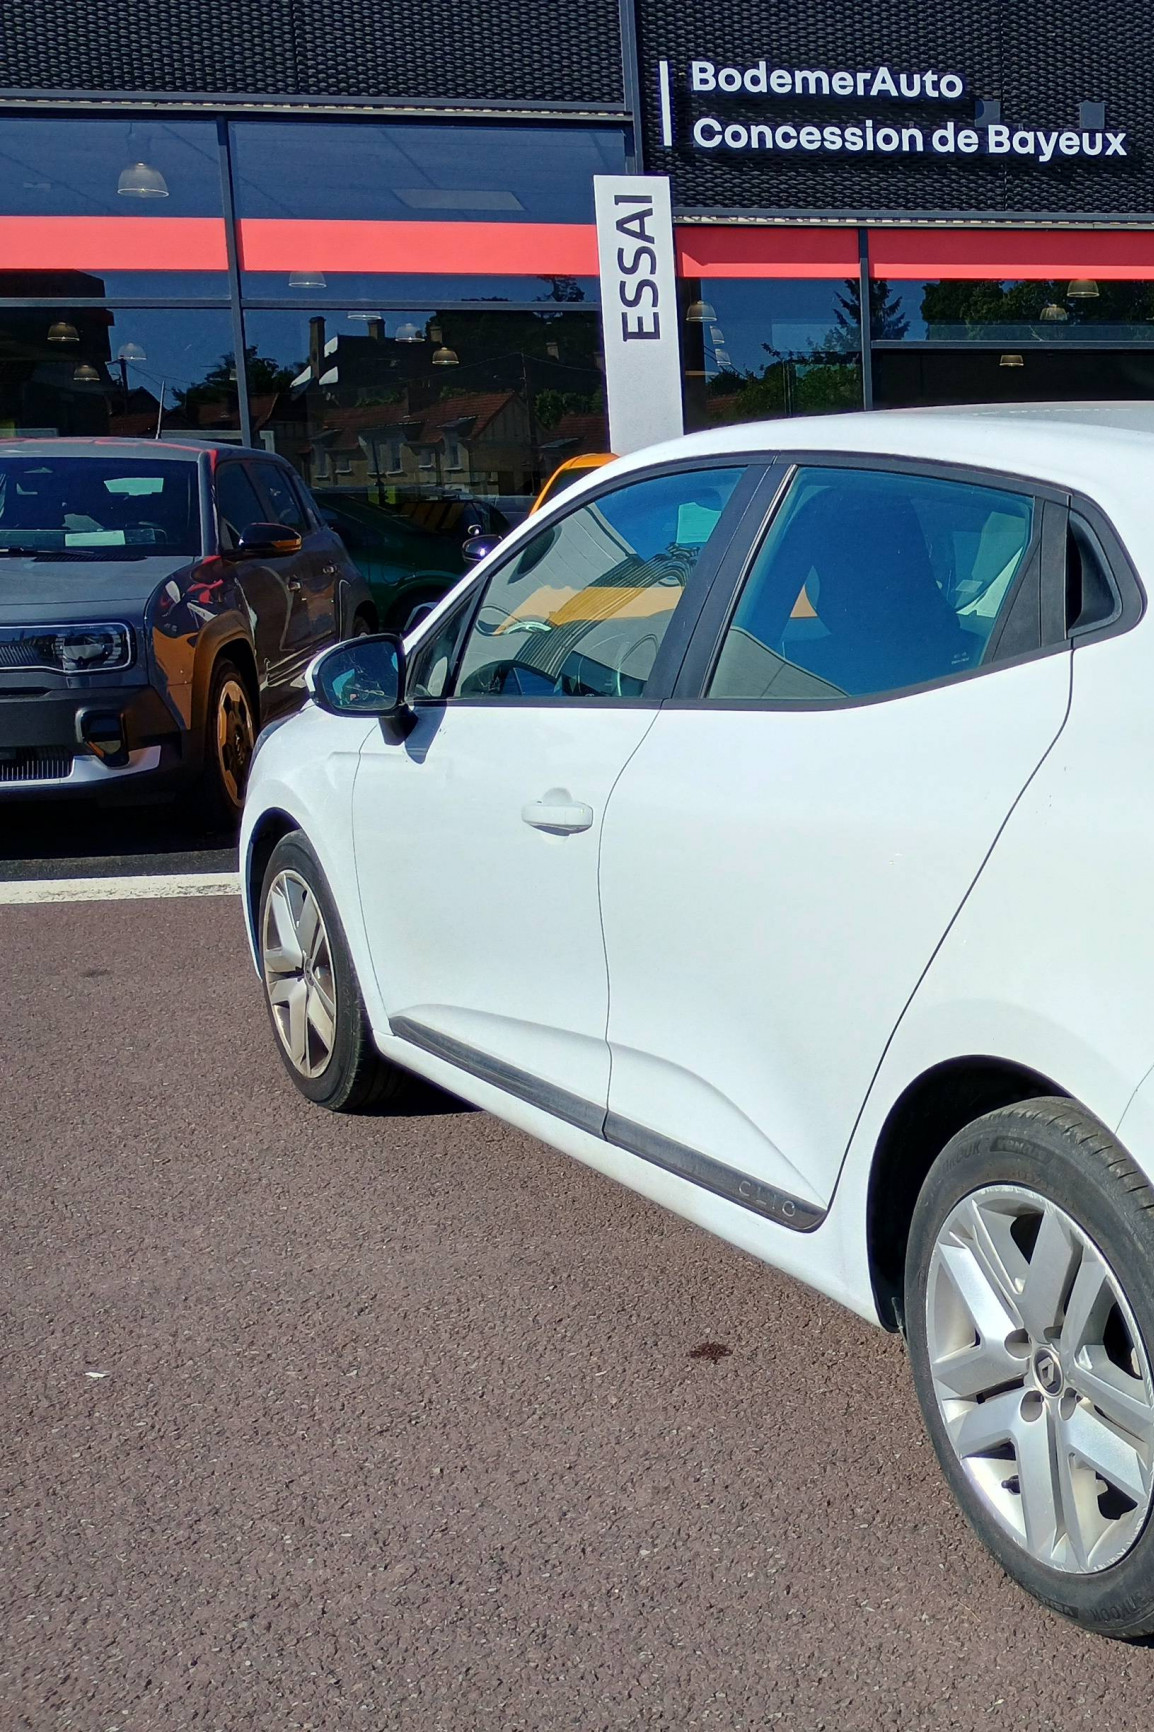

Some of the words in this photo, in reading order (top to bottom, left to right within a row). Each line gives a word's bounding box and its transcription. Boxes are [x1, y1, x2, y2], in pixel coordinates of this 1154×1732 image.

[692, 61, 963, 98] BodemerAuto
[693, 117, 924, 151] Concession
[931, 121, 979, 153] de
[987, 125, 1127, 162] Bayeux
[614, 194, 661, 342] ESSAI
[738, 1180, 796, 1217] CLIO
